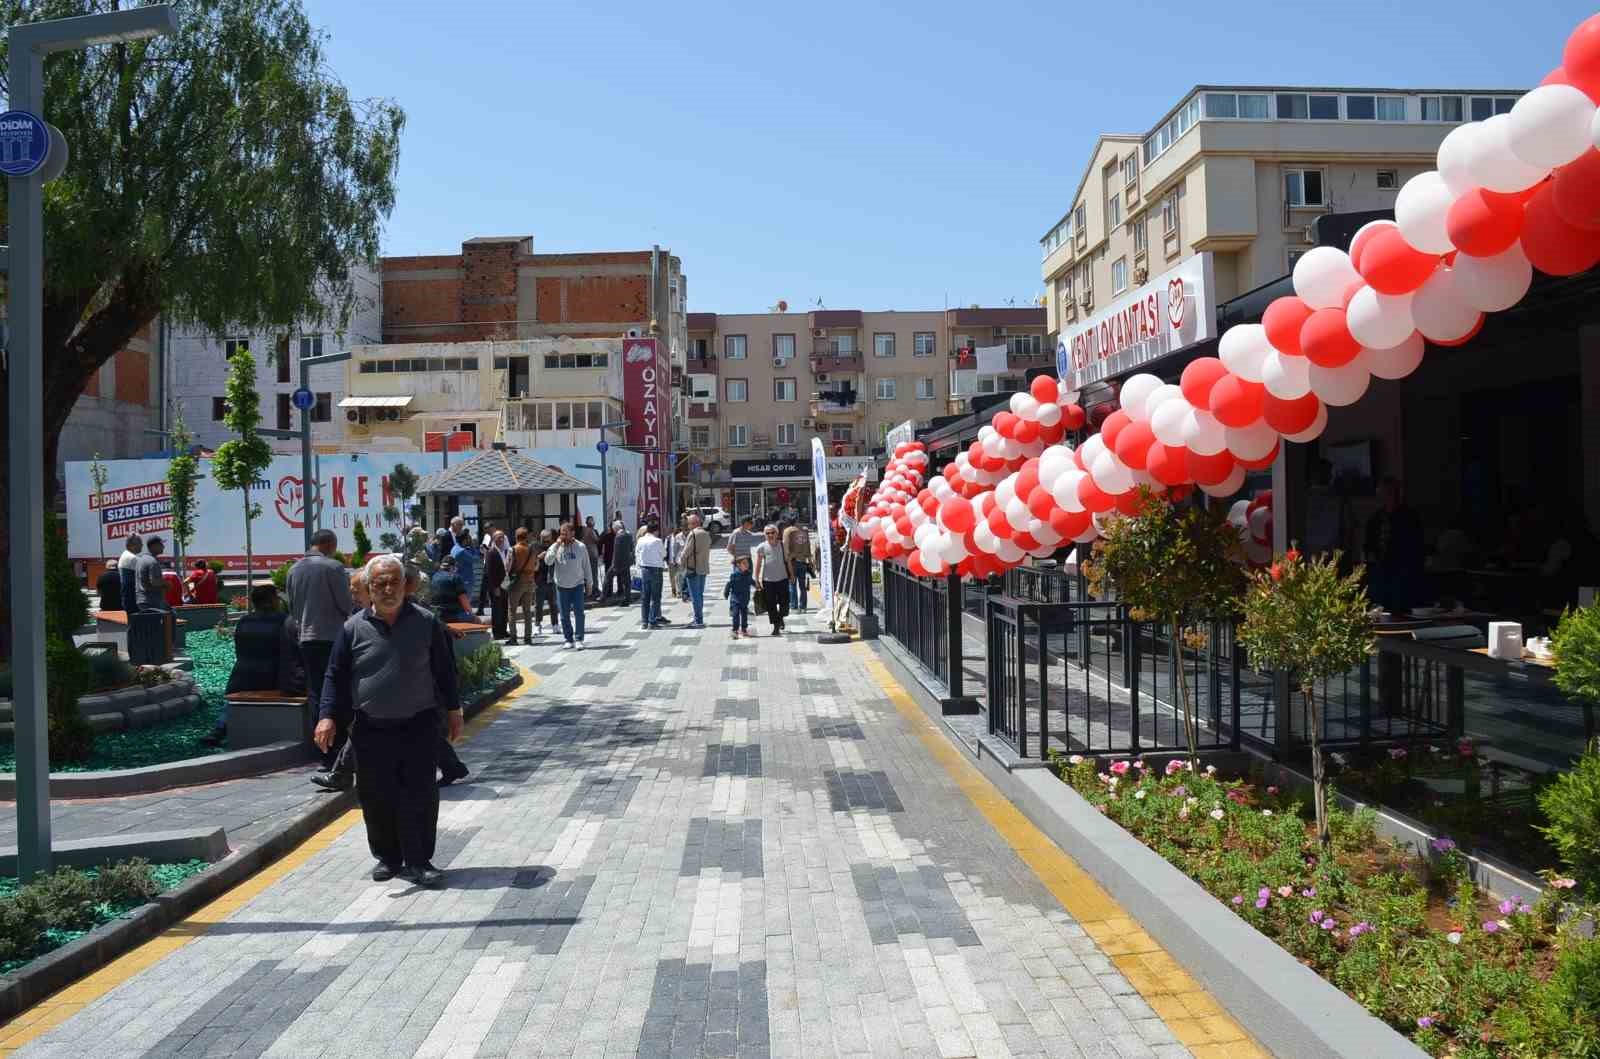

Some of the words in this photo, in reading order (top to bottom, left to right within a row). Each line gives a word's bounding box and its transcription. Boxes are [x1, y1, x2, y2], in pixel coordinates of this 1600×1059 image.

[1070, 329, 1093, 370] KENT
[1096, 291, 1160, 360] LOKANTASI
[642, 367, 660, 517] ÖZAYDINLA
